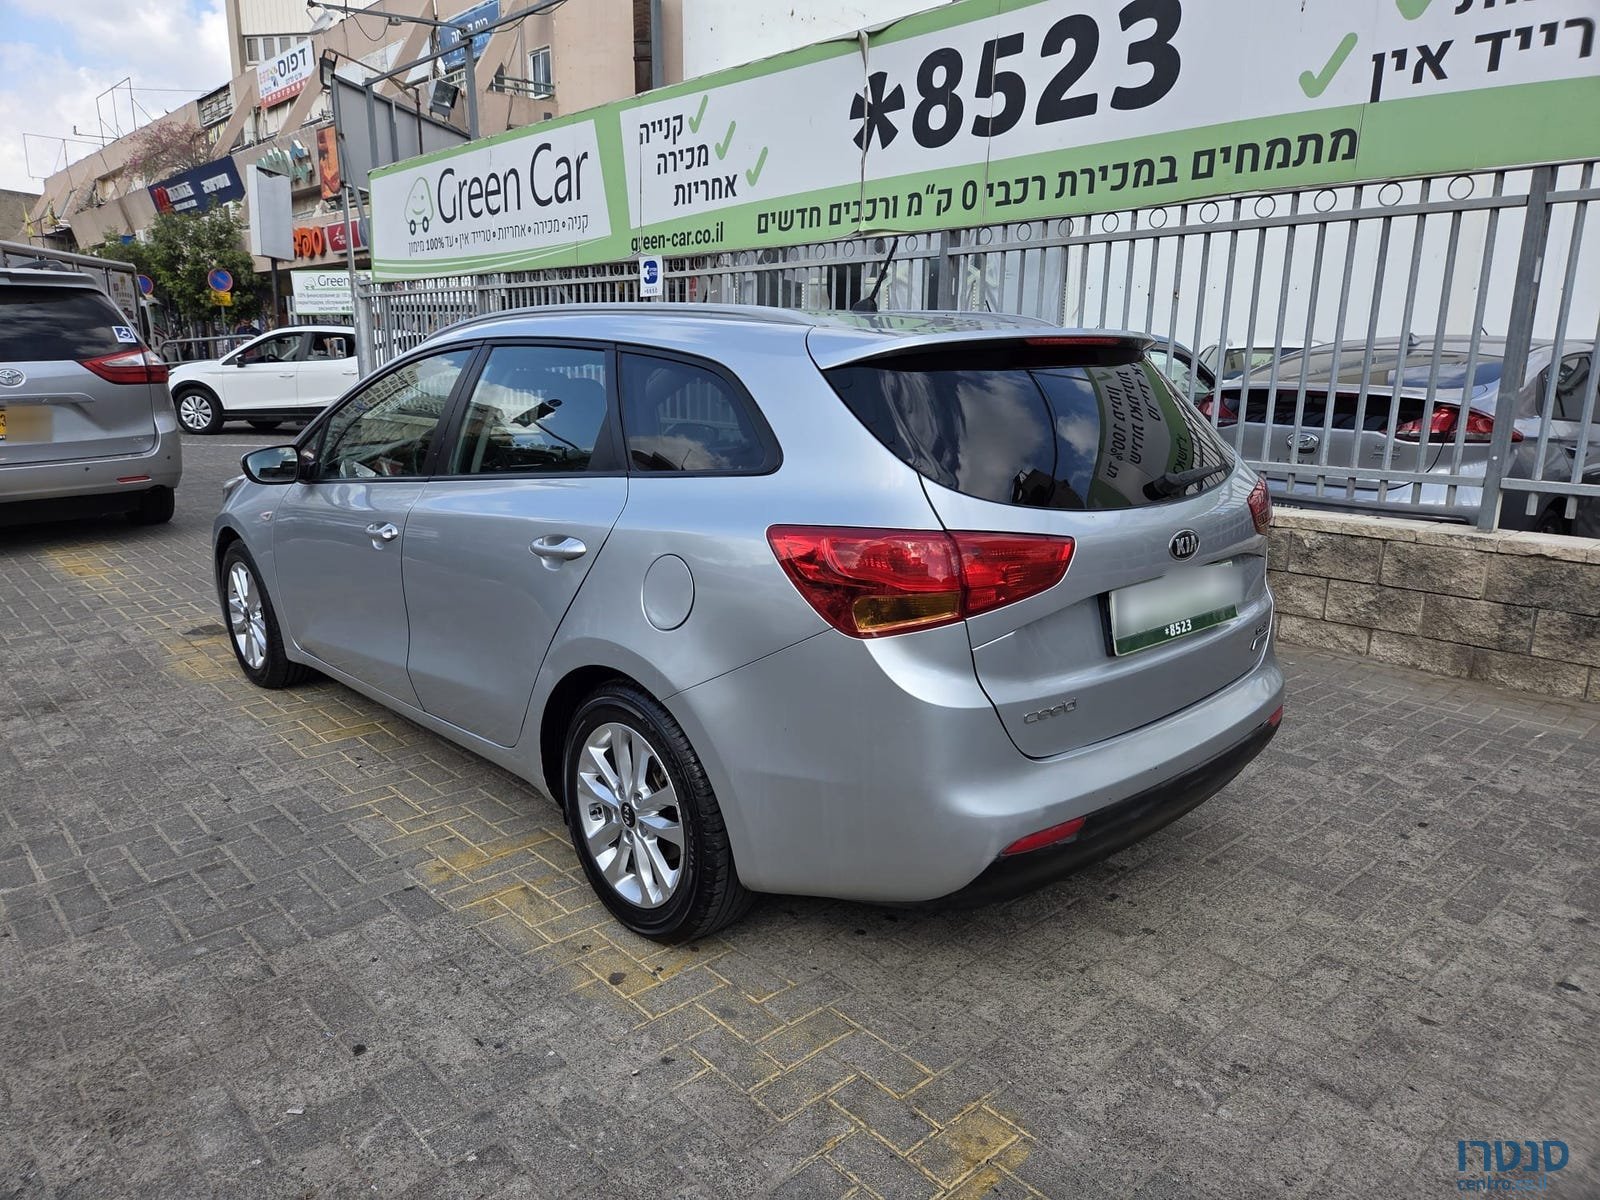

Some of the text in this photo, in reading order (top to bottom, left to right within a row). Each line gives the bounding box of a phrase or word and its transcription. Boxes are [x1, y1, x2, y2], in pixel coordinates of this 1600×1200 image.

[277, 47, 306, 78] דפוס
[1369, 17, 1596, 103] רייד אין
[639, 114, 684, 145] קנייה
[657, 143, 709, 175] מכירה
[1191, 127, 1358, 181] מתמחים
[437, 142, 589, 224] Green Car
[673, 174, 738, 206] אחריות
[988, 176, 1046, 208] רכבי
[1055, 155, 1178, 199] במכירת
[828, 194, 898, 225] ורכבים
[961, 179, 978, 211] 0
[497, 223, 527, 241] אחריות
[533, 217, 560, 236] מכירה
[566, 213, 589, 235] קניה
[757, 206, 821, 234] חדשים
[408, 241, 425, 257] מימון
[426, 237, 445, 252] 100%
[458, 231, 470, 250] אין
[470, 228, 491, 245] טרייד
[631, 221, 724, 252] green-car.co.il
[318, 274, 350, 287] Green
[1175, 534, 1199, 556] KIA
